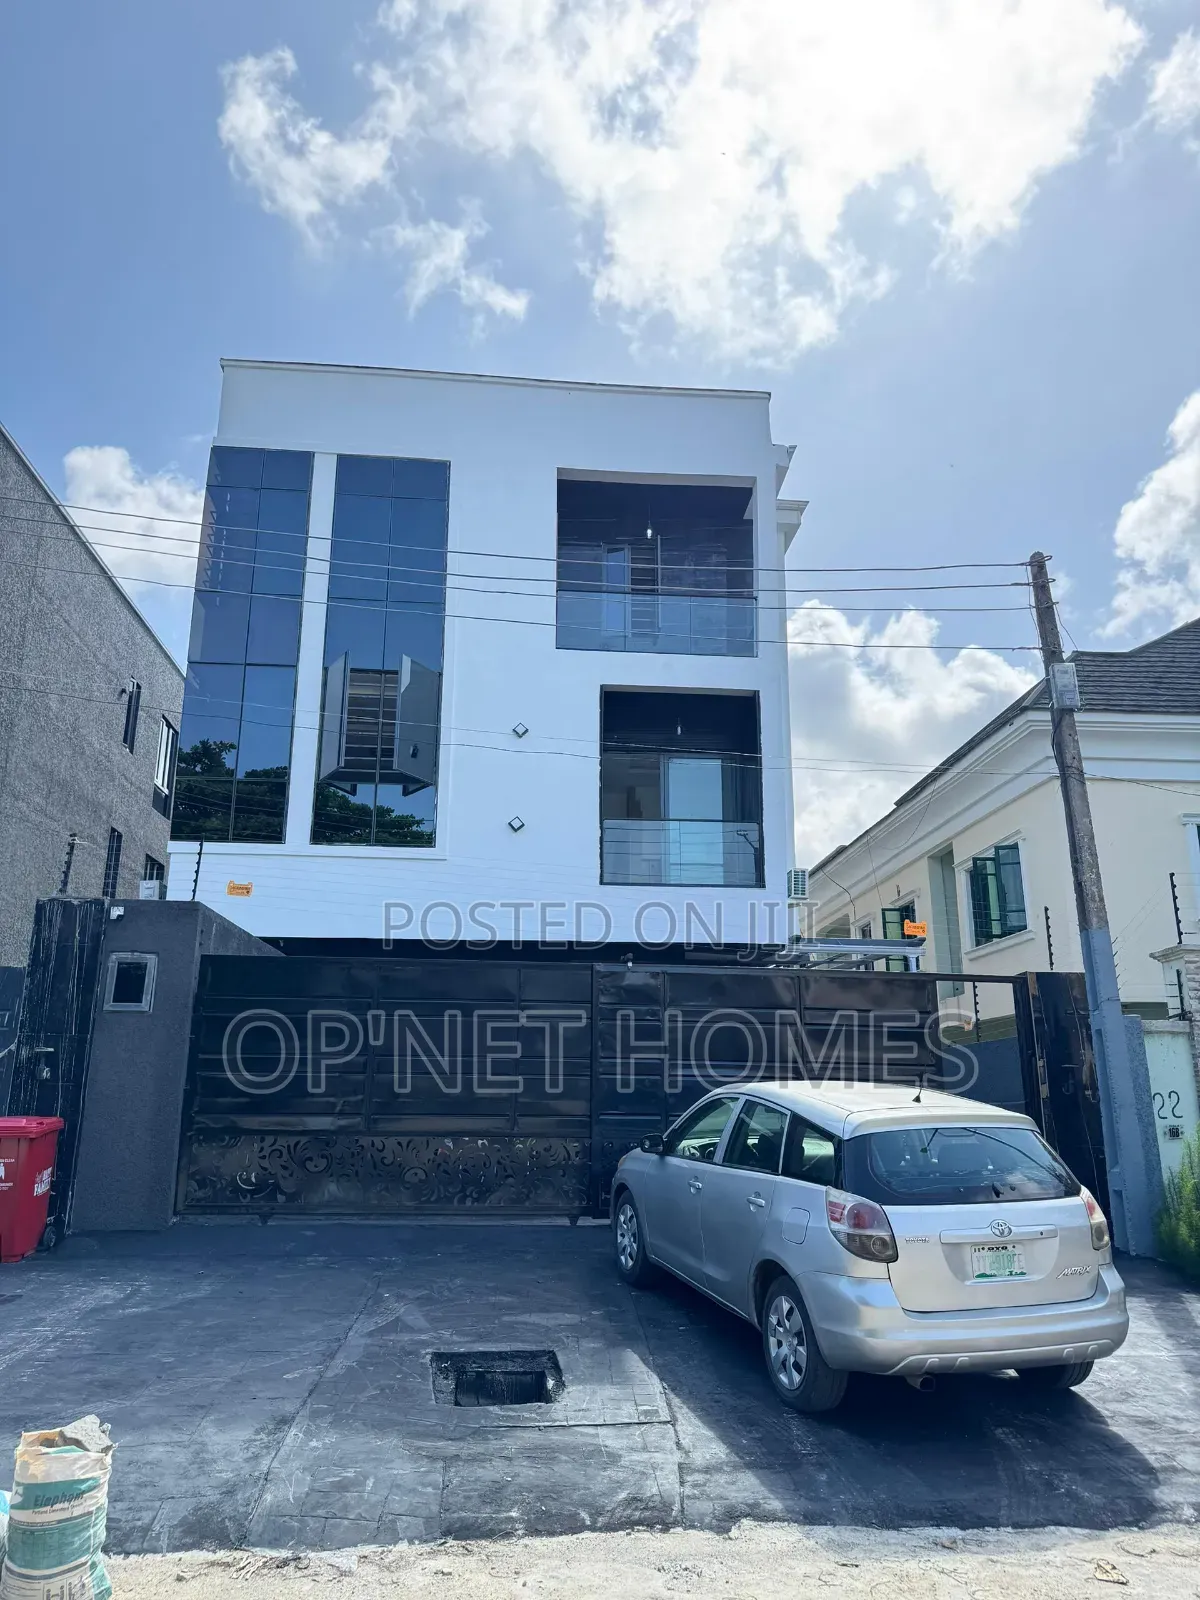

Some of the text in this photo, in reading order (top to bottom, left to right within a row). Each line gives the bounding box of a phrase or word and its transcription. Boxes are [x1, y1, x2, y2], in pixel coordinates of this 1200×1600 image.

[1152, 1090, 1183, 1120] 22
[904, 1236, 931, 1245] TOYOTA
[1055, 1265, 1092, 1280] MATRIX
[34, 1491, 85, 1508] Elephant
